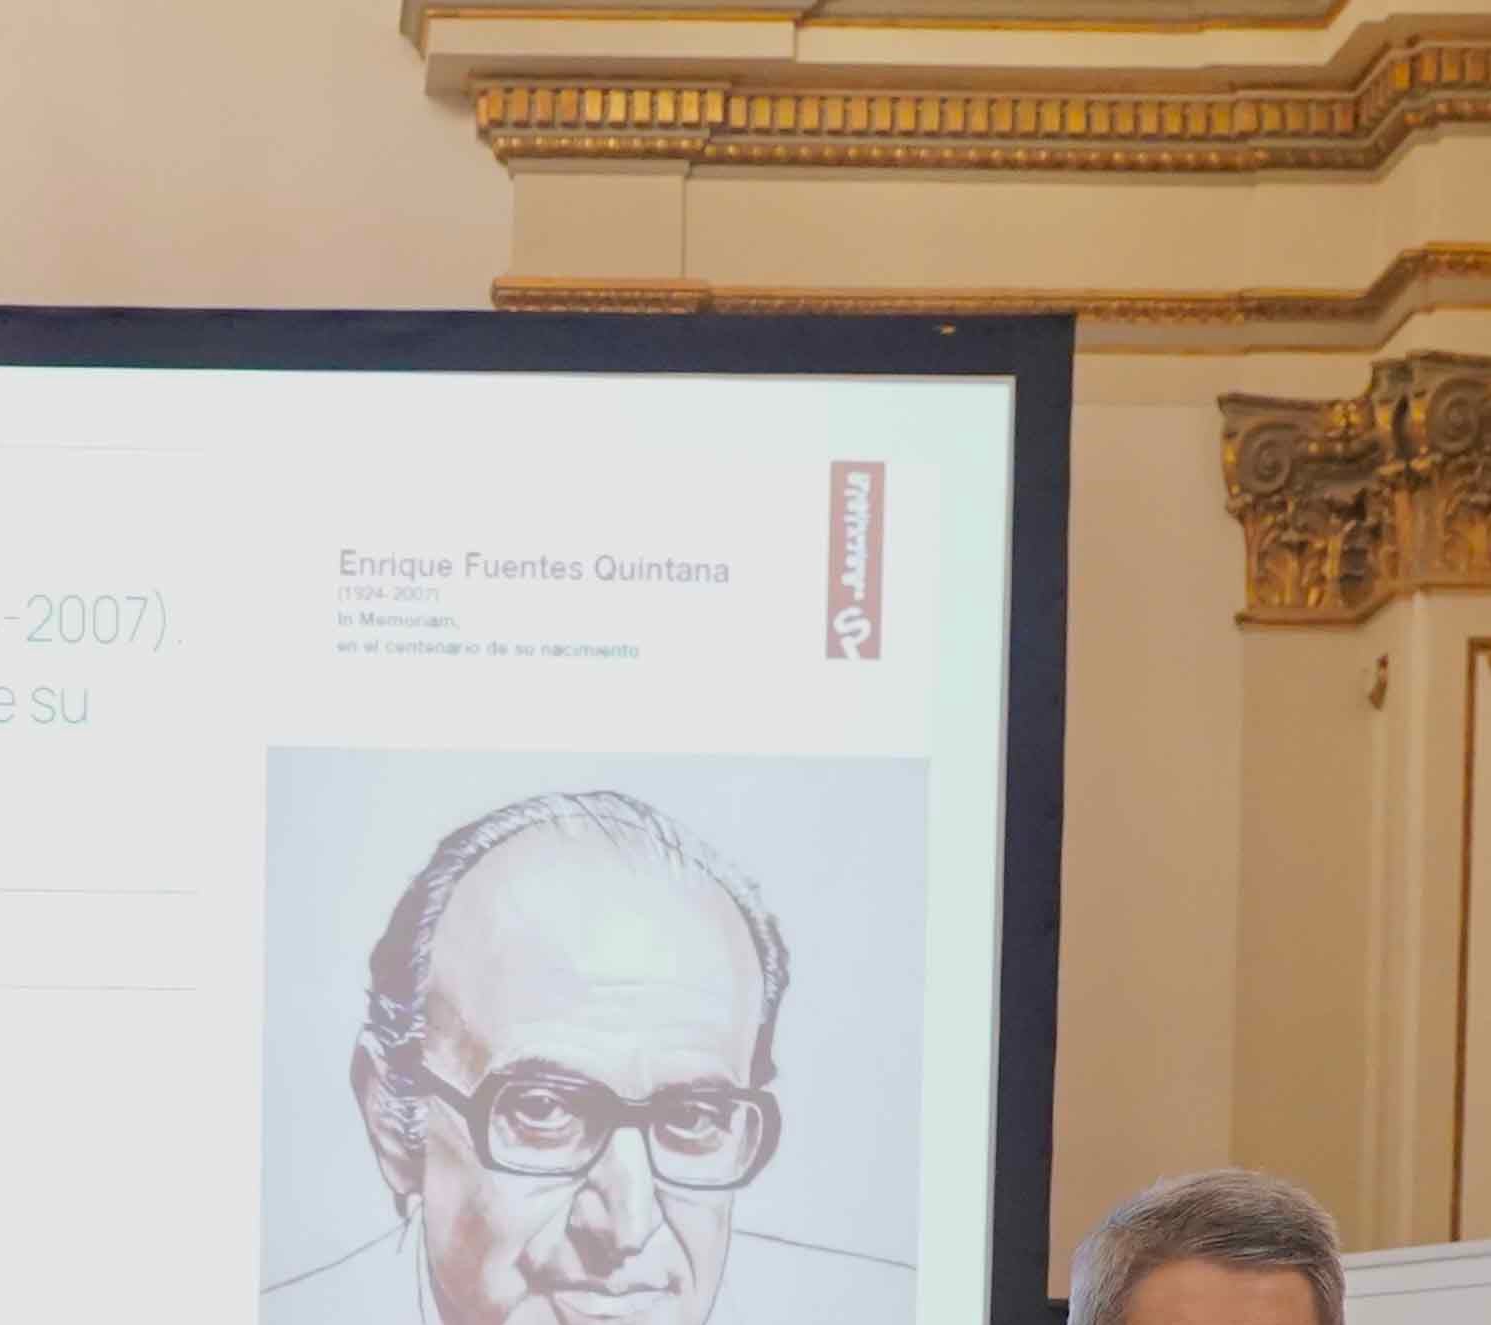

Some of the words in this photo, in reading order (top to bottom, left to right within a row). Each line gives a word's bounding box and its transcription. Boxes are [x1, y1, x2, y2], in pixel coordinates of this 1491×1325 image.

[339, 550, 453, 583] Enrique
[465, 551, 584, 582] Fuentes
[594, 554, 731, 584] Quintana
[31, 687, 88, 725] su
